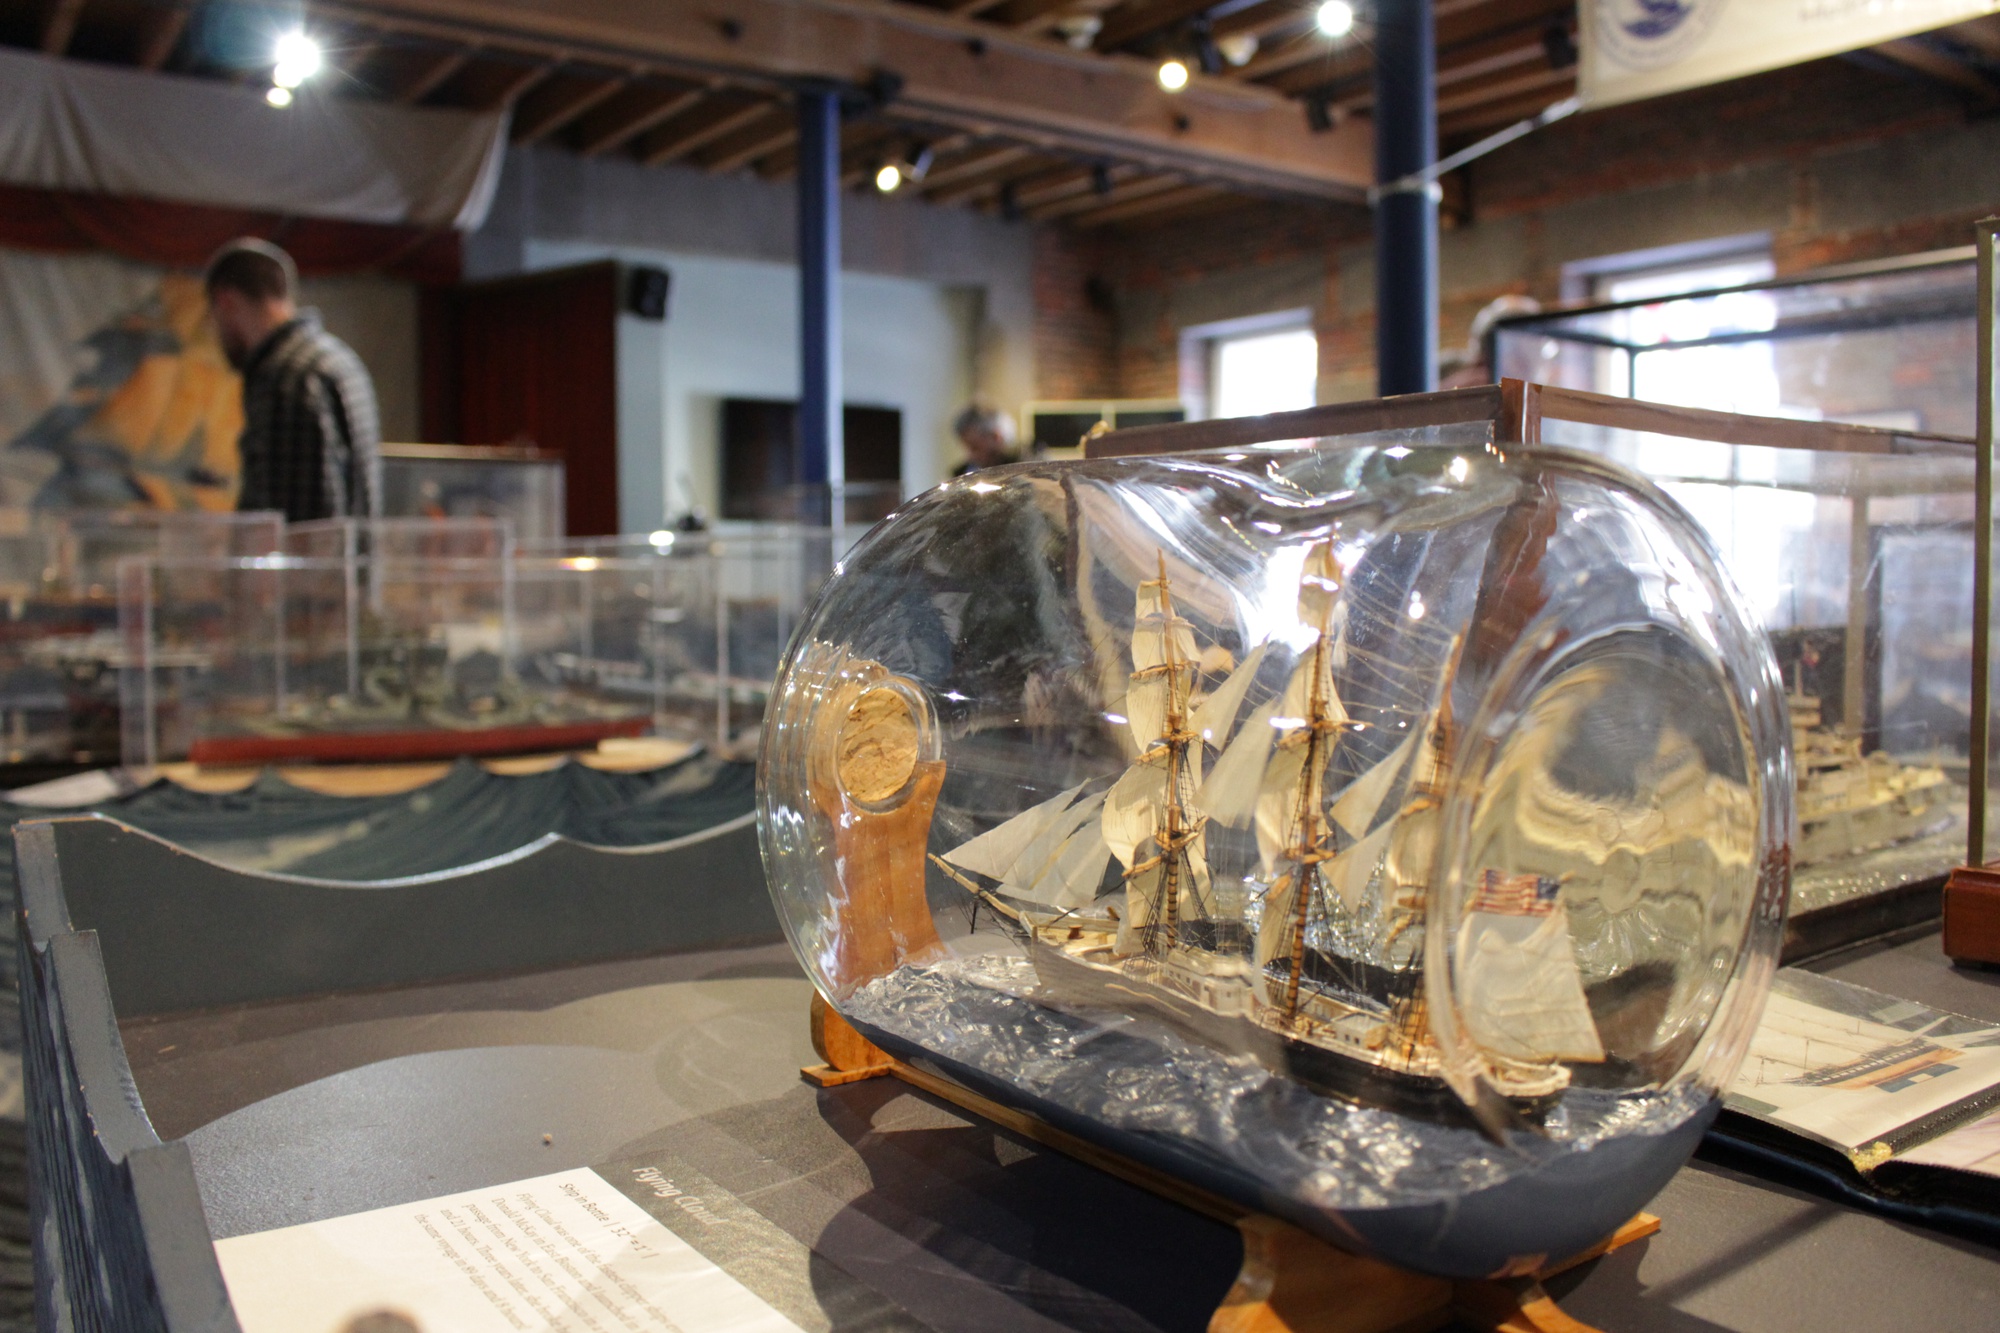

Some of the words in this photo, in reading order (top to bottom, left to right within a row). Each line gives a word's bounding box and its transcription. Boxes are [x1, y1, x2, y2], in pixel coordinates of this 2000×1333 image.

[517, 1192, 539, 1211] Flying
[534, 1208, 557, 1226] Cloud
[554, 1222, 570, 1237] was
[566, 1235, 582, 1248] one
[559, 1183, 579, 1198] Ship
[576, 1195, 588, 1207] in
[582, 1201, 610, 1222] Bottle
[632, 1166, 682, 1198] Flying
[674, 1196, 729, 1225] Cloud
[423, 1223, 442, 1239] same
[437, 1238, 460, 1260] voyage
[461, 1203, 492, 1225] passage
[486, 1223, 506, 1239] from
[504, 1237, 521, 1252] New
[516, 1251, 538, 1267] York
[491, 1197, 522, 1219] Donald
[515, 1217, 539, 1238] McKay
[541, 1243, 561, 1259] East
[555, 1256, 583, 1279] Boston
